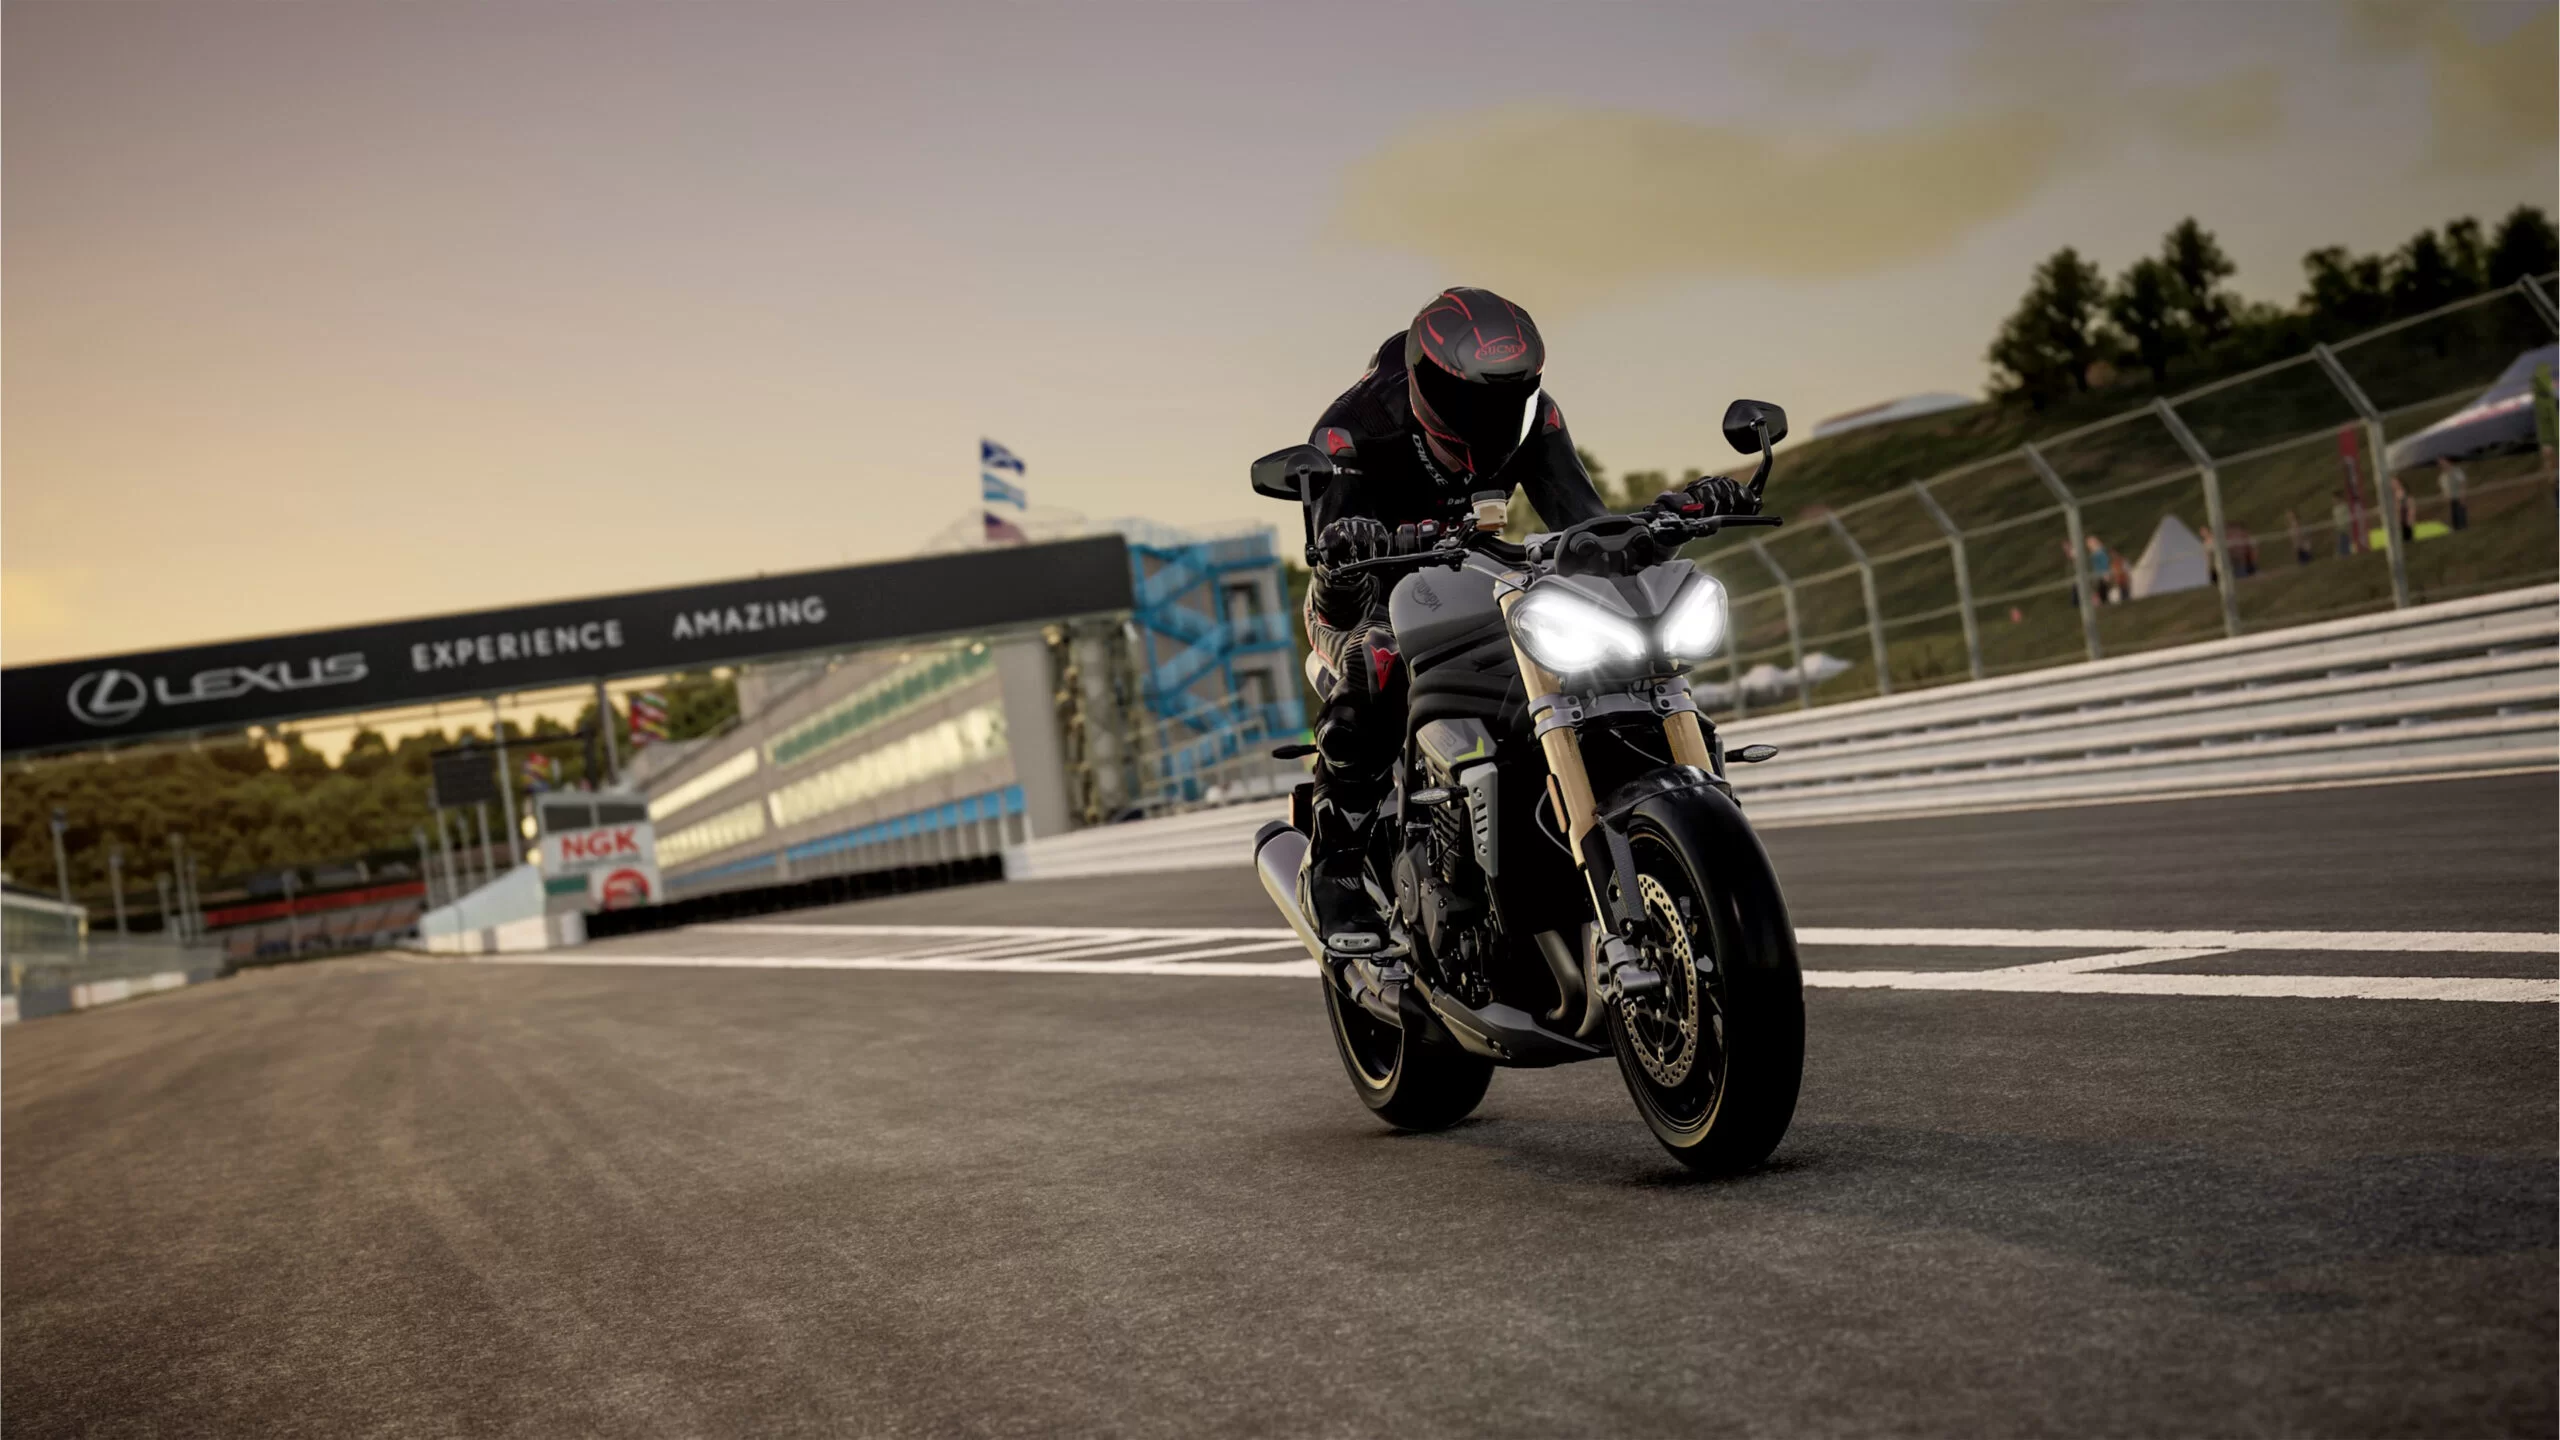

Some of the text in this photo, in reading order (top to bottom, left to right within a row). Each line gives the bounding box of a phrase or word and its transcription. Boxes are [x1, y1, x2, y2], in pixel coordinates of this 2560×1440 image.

[410, 595, 828, 673] EXPERIENCE AMAZING
[153, 651, 370, 706] LEXUS
[560, 824, 640, 862] NGK
